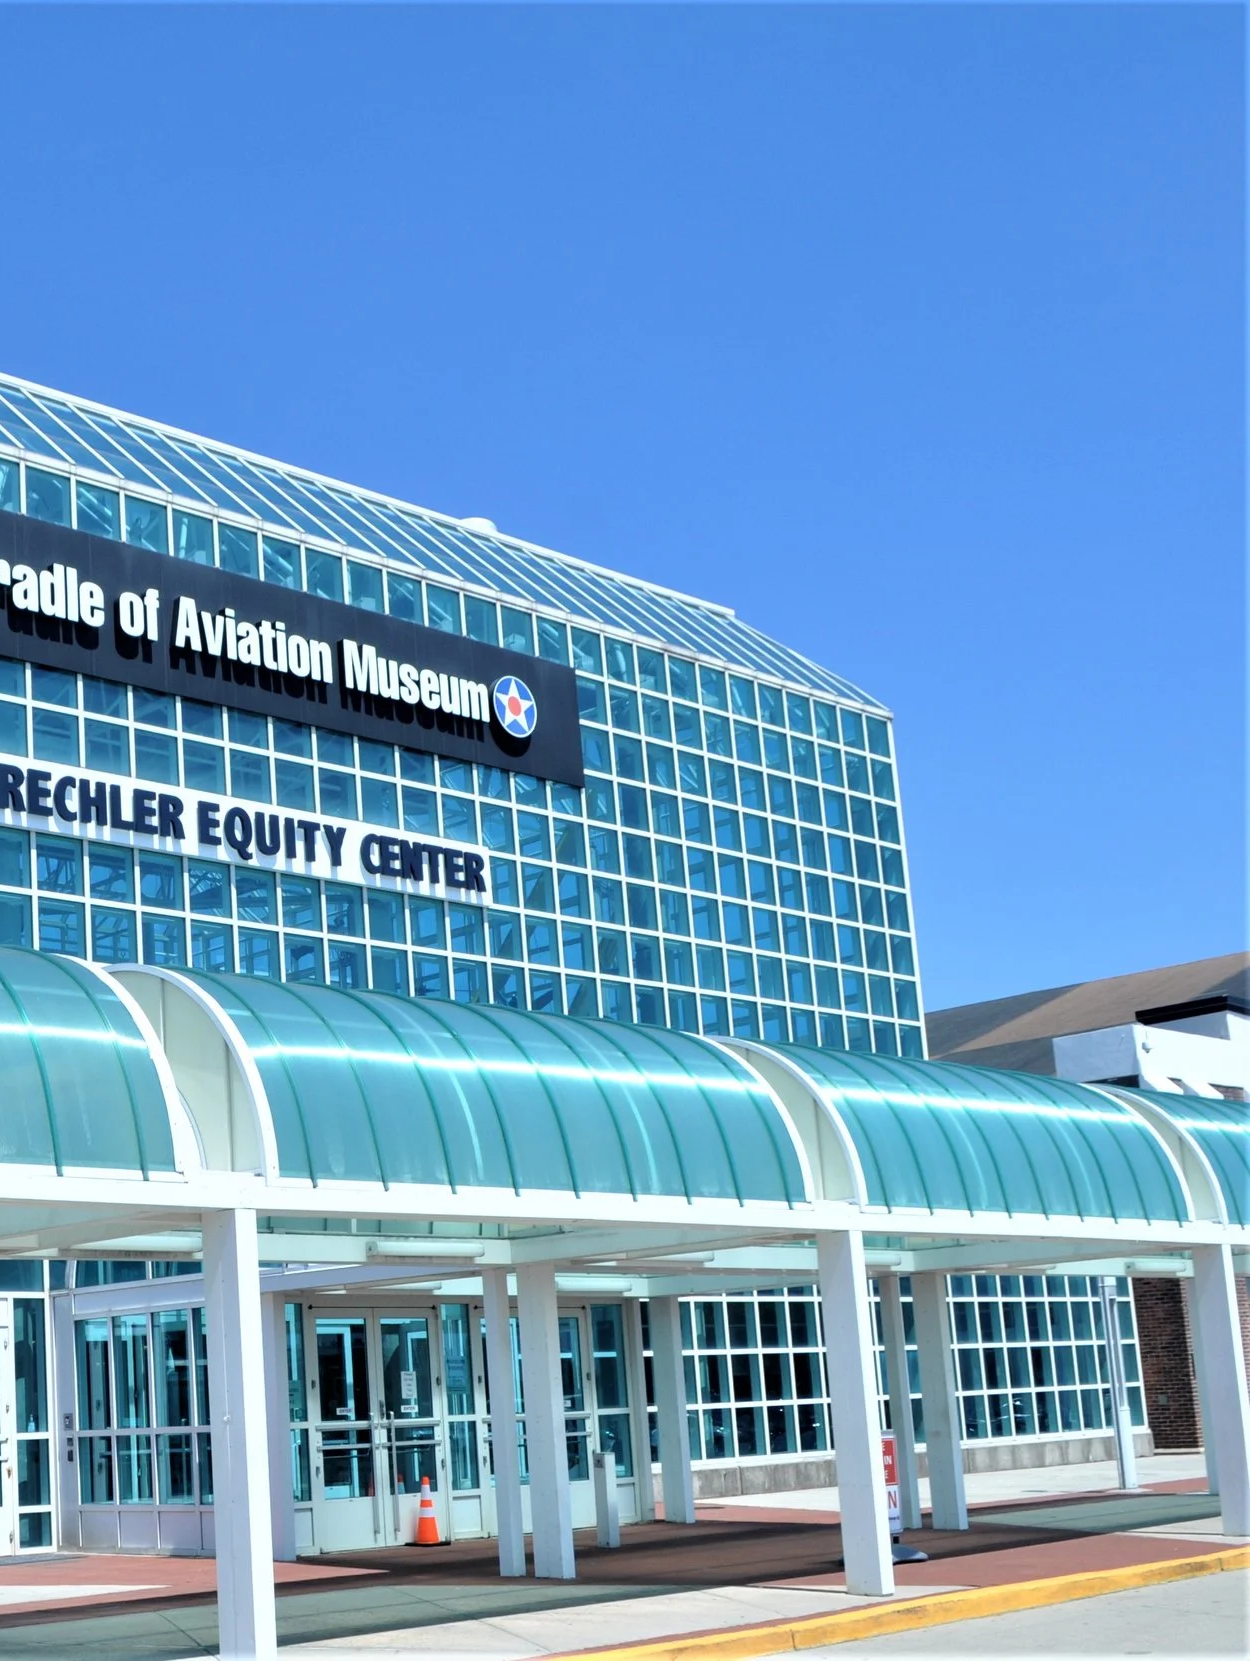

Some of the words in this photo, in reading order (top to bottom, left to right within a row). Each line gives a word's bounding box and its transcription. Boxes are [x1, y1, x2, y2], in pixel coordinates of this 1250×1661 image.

[119, 588, 159, 641] of
[175, 596, 333, 684] Aviation
[343, 638, 491, 723] Museum
[197, 801, 347, 868] EQUITY
[360, 834, 487, 893] CENTER
